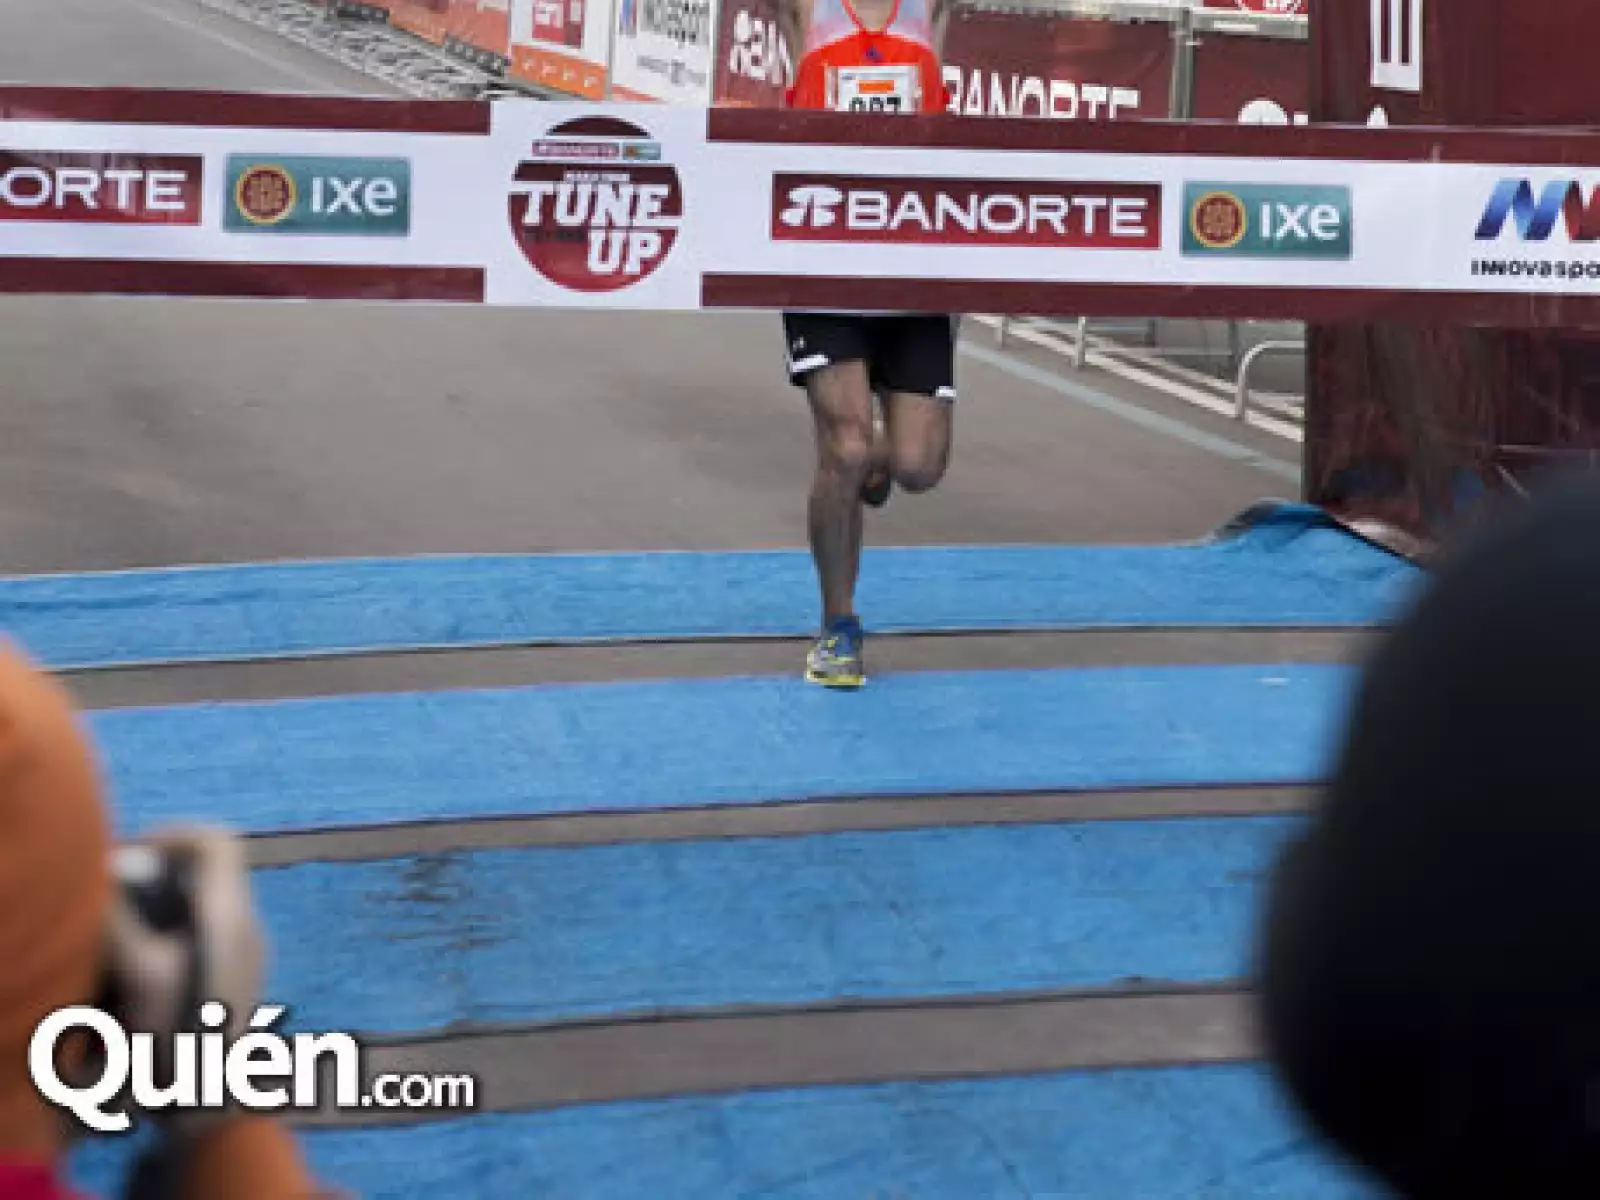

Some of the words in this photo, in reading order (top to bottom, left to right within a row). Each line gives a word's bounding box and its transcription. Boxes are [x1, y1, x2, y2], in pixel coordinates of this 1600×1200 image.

[0, 166, 189, 211] ORTE
[508, 180, 684, 228] TUNE
[846, 189, 1149, 237] BANORTE
[586, 228, 663, 276] UP
